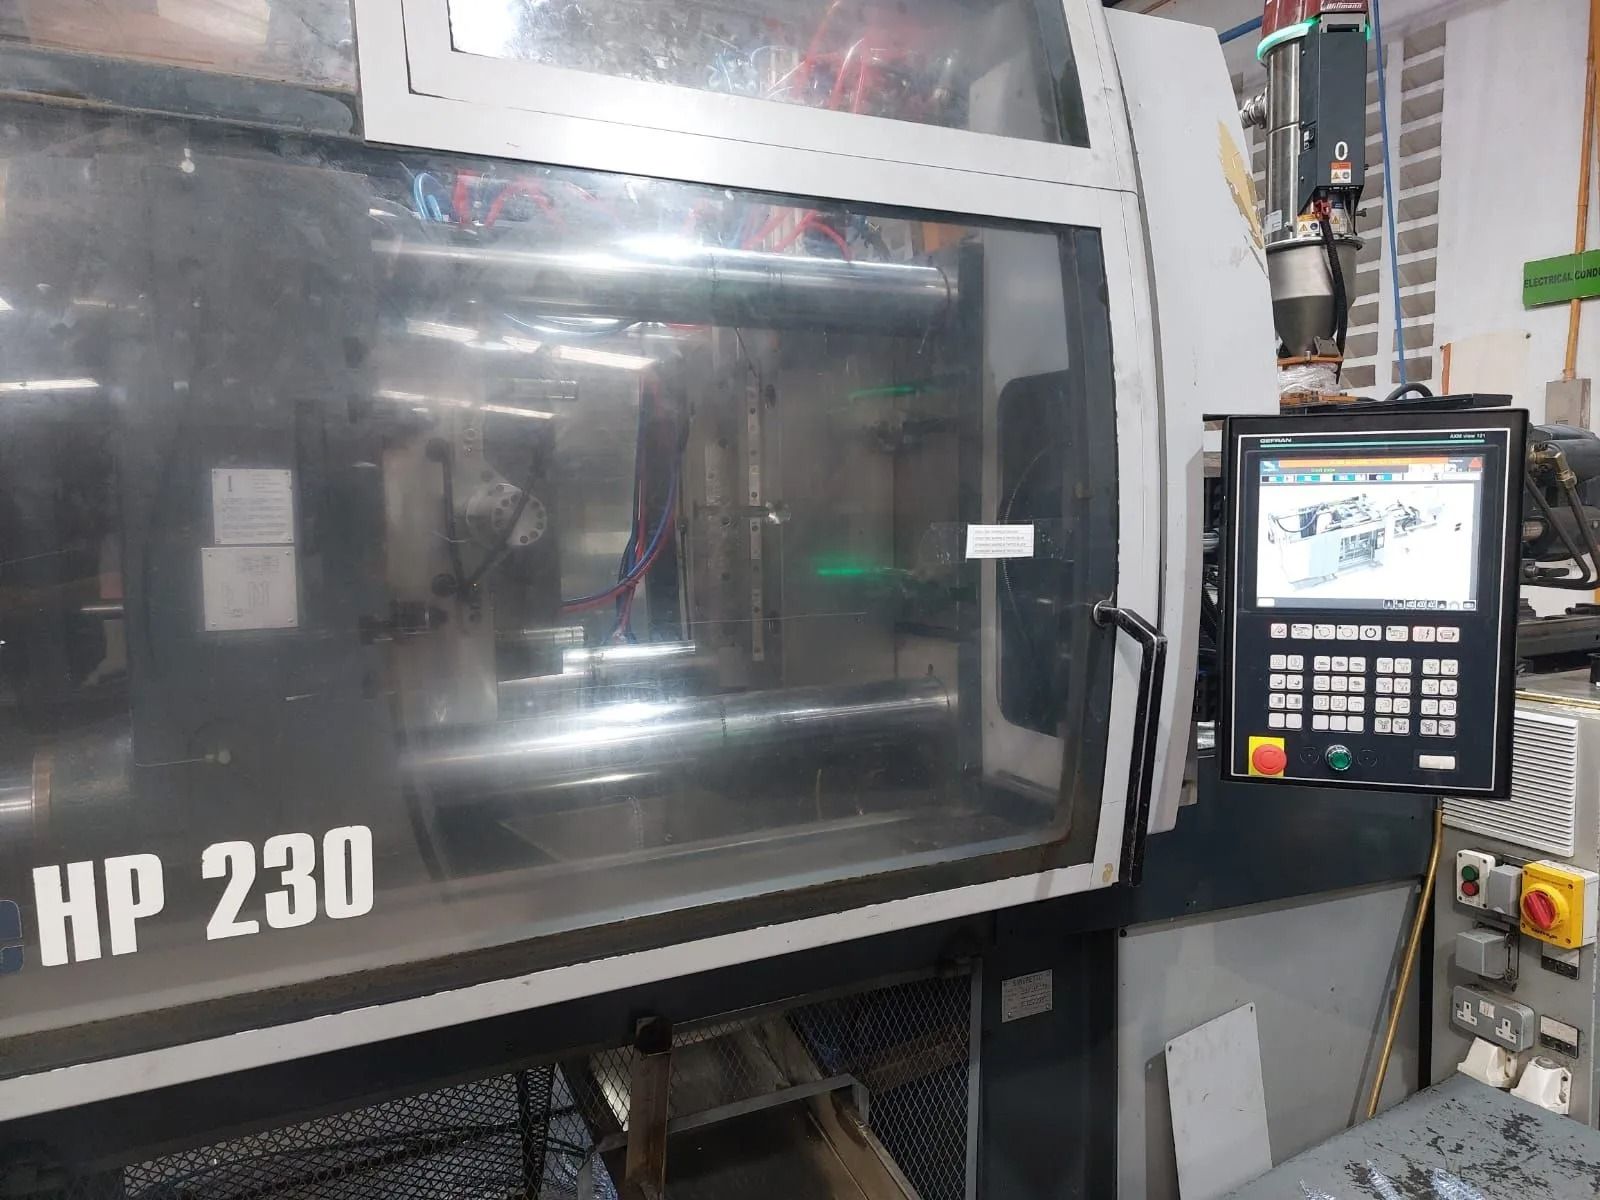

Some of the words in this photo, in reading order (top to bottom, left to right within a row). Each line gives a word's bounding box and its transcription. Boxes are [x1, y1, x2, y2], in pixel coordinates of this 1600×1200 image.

[1524, 272, 1573, 288] ELECTRICAL
[33, 853, 165, 966] HP
[202, 825, 374, 940] 230
